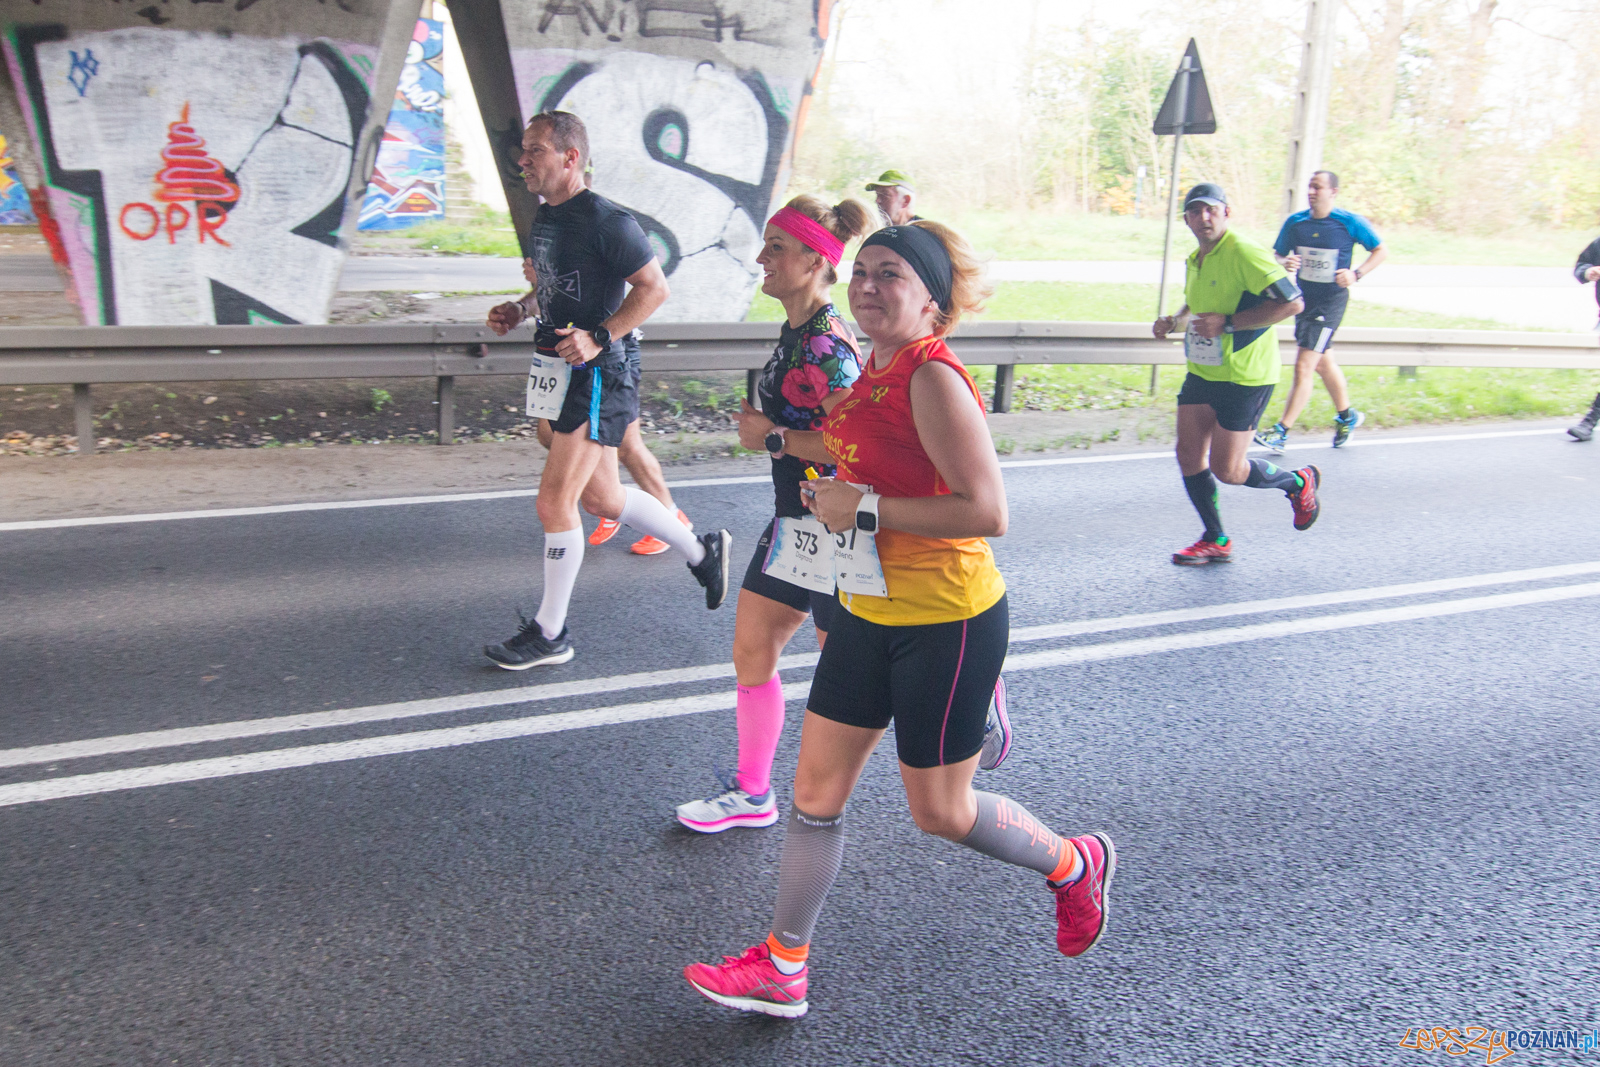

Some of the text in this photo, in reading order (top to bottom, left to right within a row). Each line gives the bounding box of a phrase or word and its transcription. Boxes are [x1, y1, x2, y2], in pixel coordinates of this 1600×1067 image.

[119, 202, 231, 249] OPR
[529, 374, 558, 394] 749
[793, 528, 819, 556] 373
